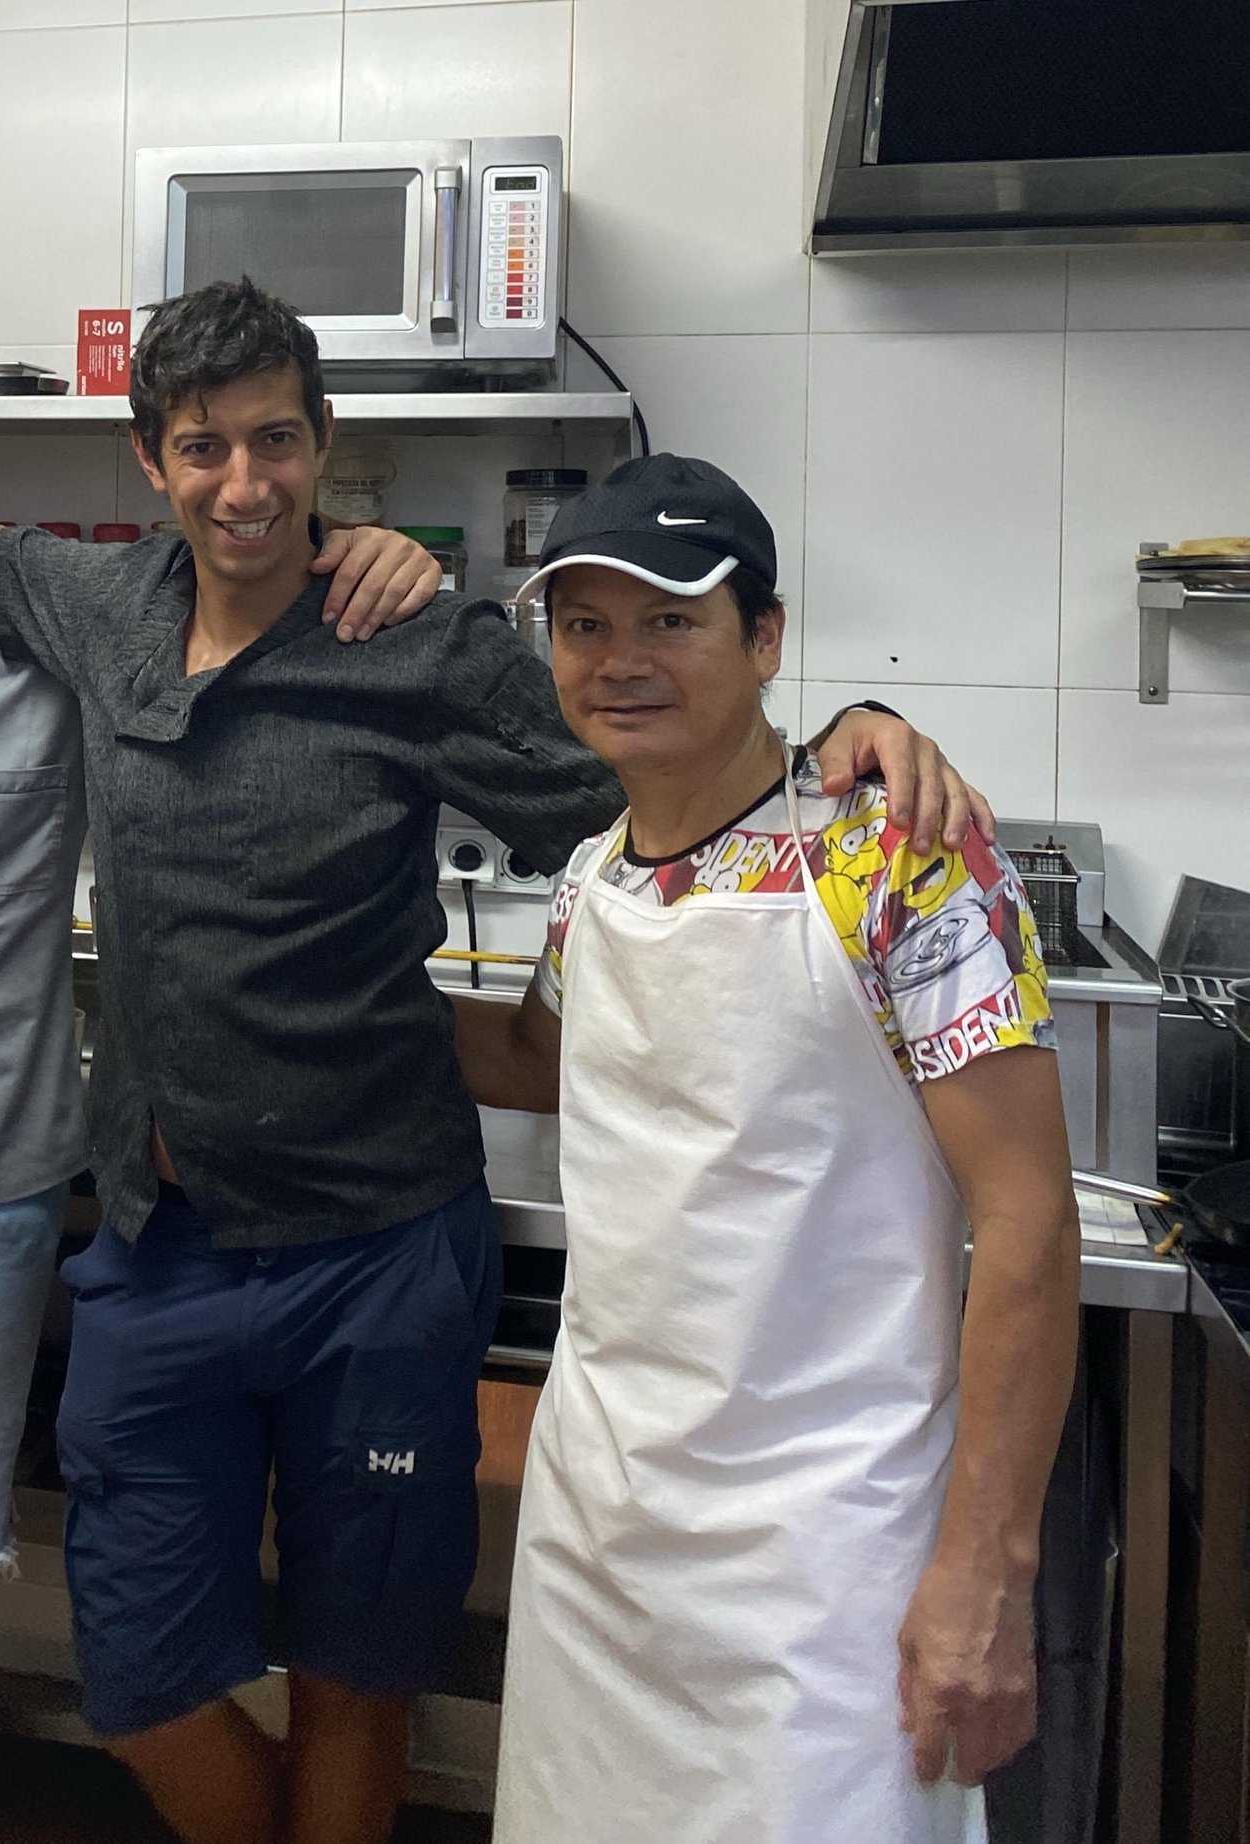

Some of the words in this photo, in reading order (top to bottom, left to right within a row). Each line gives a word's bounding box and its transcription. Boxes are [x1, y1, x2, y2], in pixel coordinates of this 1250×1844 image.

[92, 320, 101, 336] 6-7
[107, 321, 124, 335] S
[117, 345, 126, 372] nitrilo
[905, 979, 1023, 1083] SIDENT
